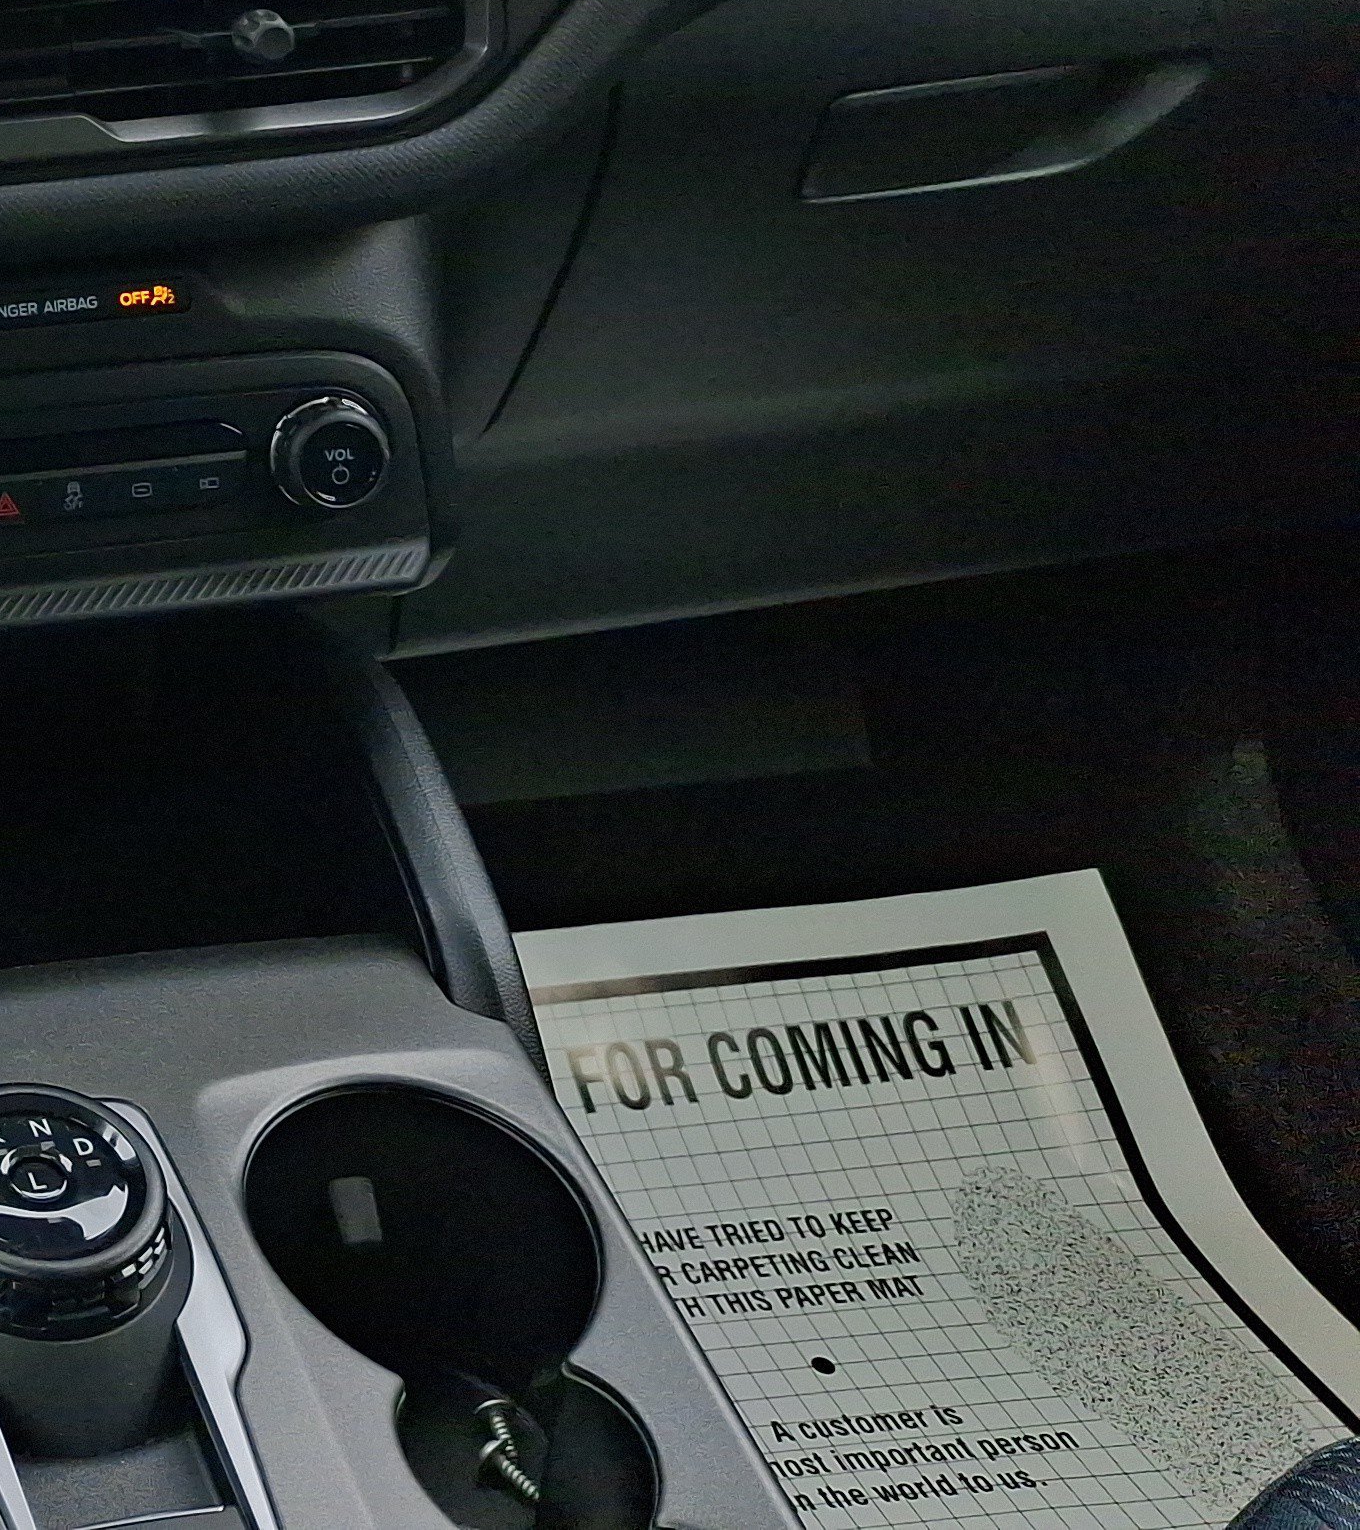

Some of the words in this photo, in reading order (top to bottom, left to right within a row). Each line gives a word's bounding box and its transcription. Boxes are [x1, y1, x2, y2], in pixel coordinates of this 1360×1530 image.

[43, 295, 98, 314] AIRBAG
[119, 289, 150, 307] OFF
[324, 448, 355, 462] VOL
[566, 1036, 699, 1114] FOR
[705, 1010, 958, 1100] COMING
[960, 1000, 1038, 1070] IN
[29, 1118, 52, 1138] N
[72, 1137, 94, 1156] D
[27, 1171, 48, 1191] L
[707, 1219, 785, 1247] TRIED
[787, 1213, 826, 1239] TO
[829, 1208, 893, 1236] KEEP
[680, 1249, 830, 1285] CARPETING
[833, 1241, 921, 1270] CLEAN
[709, 1289, 773, 1314] THIS
[775, 1280, 866, 1309] PAPER
[867, 1274, 925, 1301] MAT
[771, 1420, 796, 1443] A
[798, 1408, 929, 1441] customer
[930, 1405, 964, 1426] is
[830, 1436, 975, 1473] important
[977, 1429, 1080, 1462] person
[819, 1483, 871, 1510] the
[871, 1472, 959, 1504] world
[959, 1471, 994, 1494] to
[995, 1468, 1049, 1491] us.
